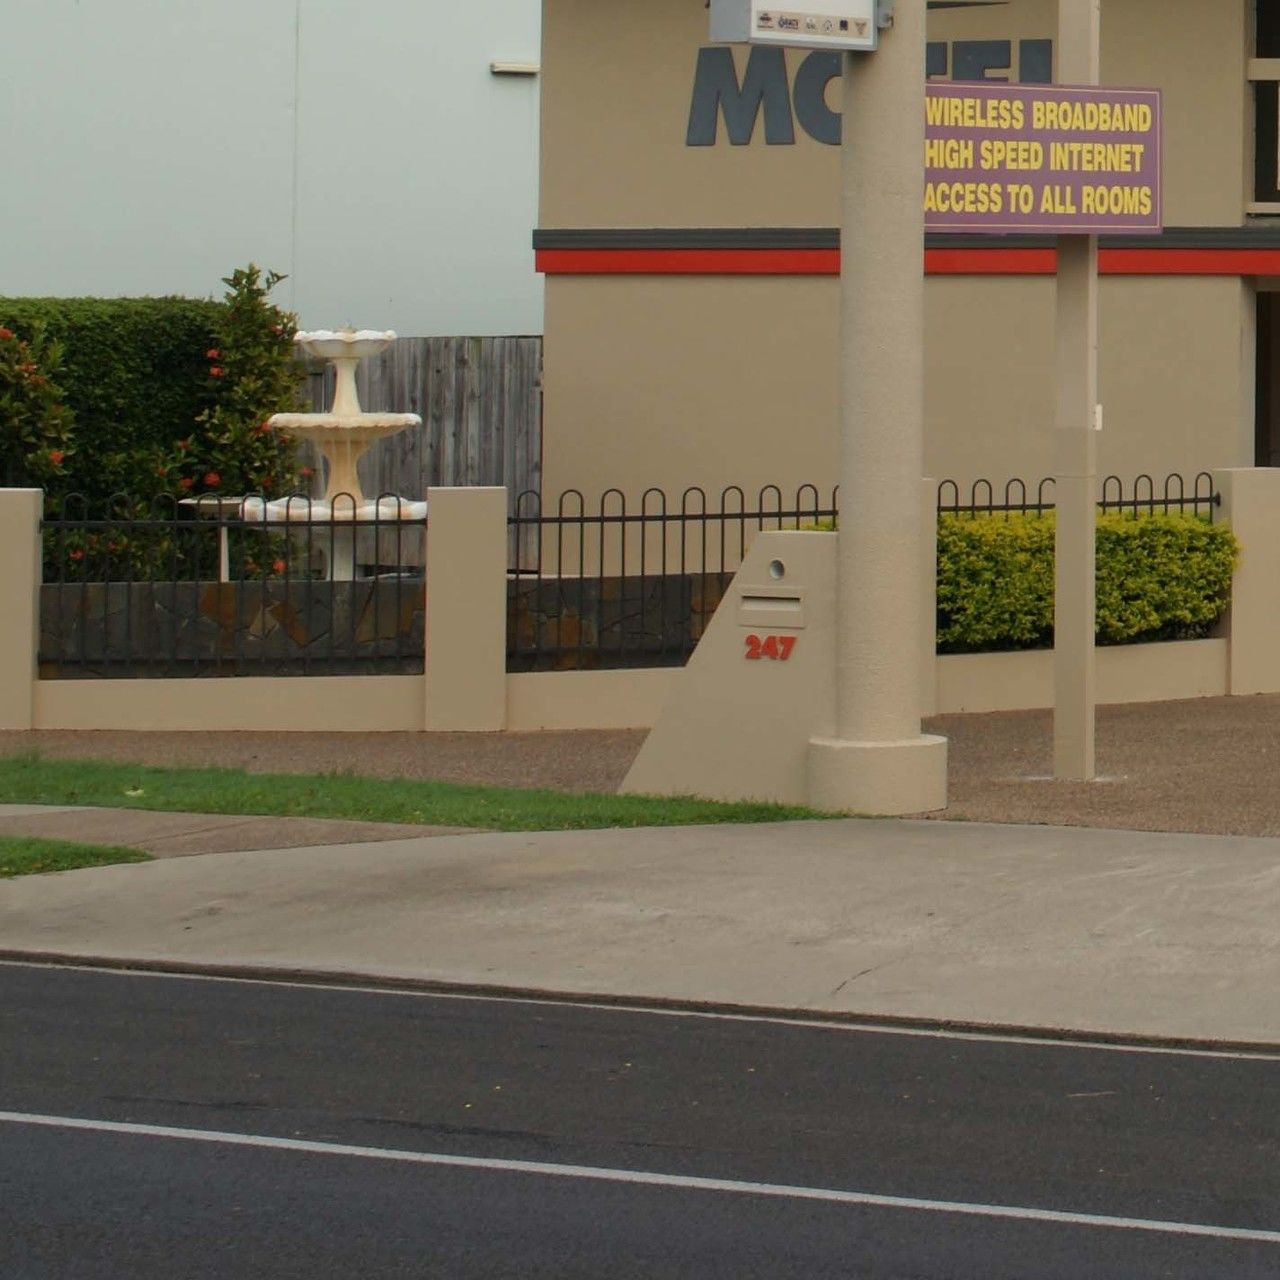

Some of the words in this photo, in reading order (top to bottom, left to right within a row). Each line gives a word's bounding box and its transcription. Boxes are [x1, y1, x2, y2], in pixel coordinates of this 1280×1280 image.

[925, 97, 1024, 129] WIRELESS
[1033, 100, 1152, 132] BROADBAND
[925, 139, 974, 169] HIGH
[980, 140, 1043, 170] SPEED
[1050, 142, 1144, 172] INTERNET
[924, 182, 1002, 213] ACCESS
[1006, 184, 1034, 213] TO
[1040, 185, 1077, 214] ALL
[1082, 185, 1152, 215] ROOMS
[745, 634, 798, 661] 247
